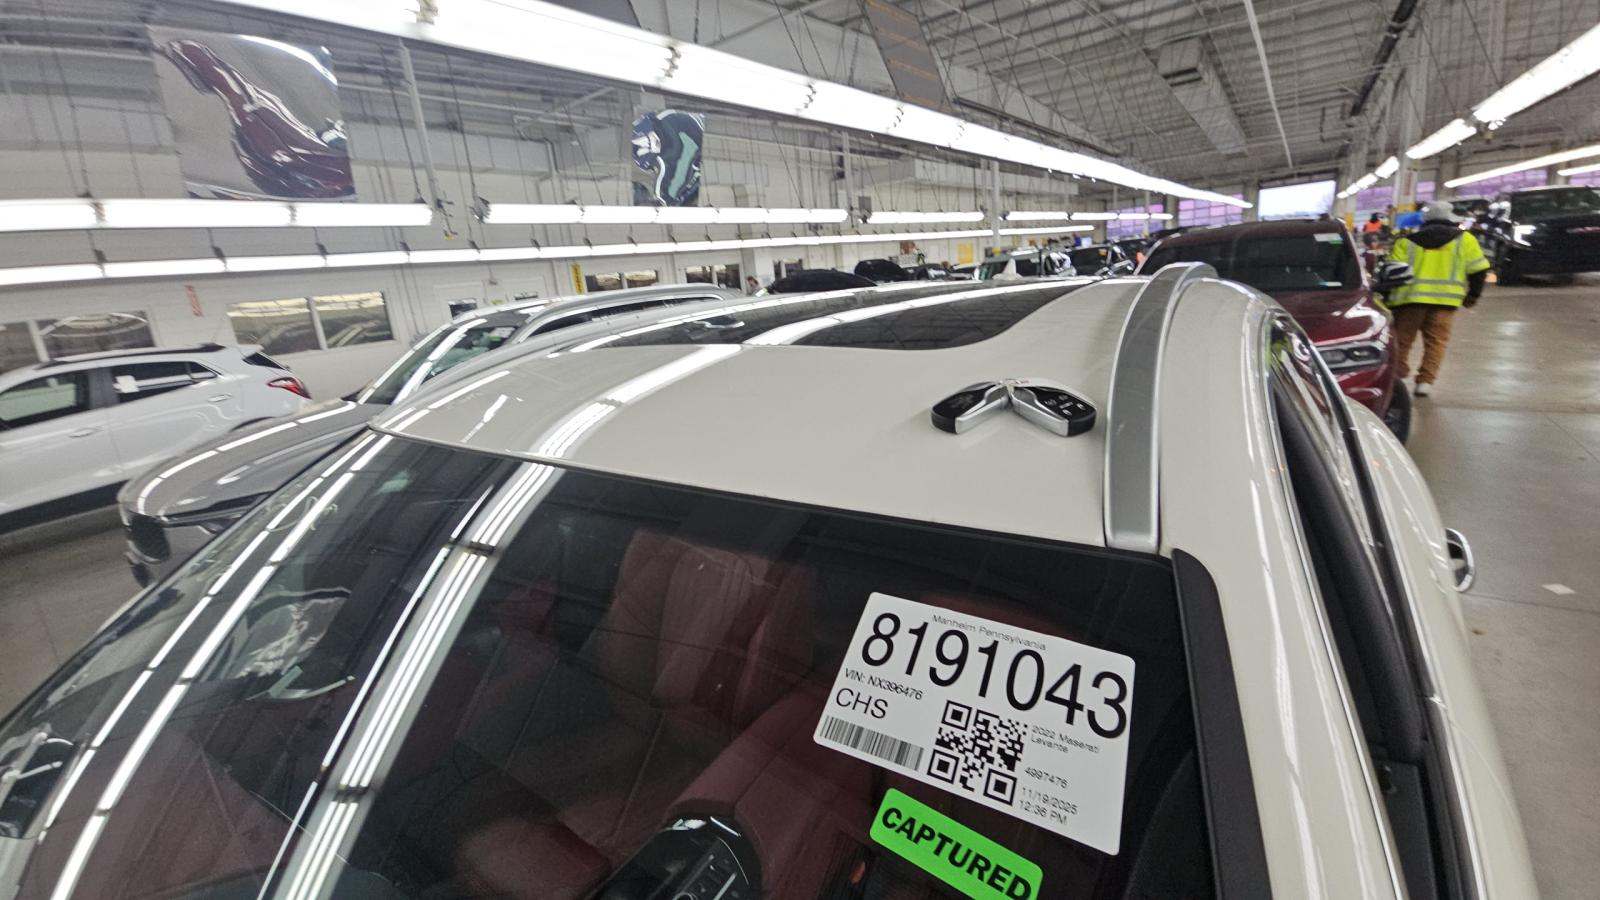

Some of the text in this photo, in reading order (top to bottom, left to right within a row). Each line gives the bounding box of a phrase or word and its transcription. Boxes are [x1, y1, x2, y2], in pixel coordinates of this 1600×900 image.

[932, 615, 1046, 651] Manheim Pennsylvania
[845, 668, 923, 700] VIN: NX396476
[861, 612, 1128, 739] 8191043
[836, 688, 888, 718] CHS
[1032, 726, 1055, 739] 2022
[1032, 736, 1068, 753] Levante
[1051, 811, 1067, 824] PM
[881, 806, 1032, 900] CAPTURED
